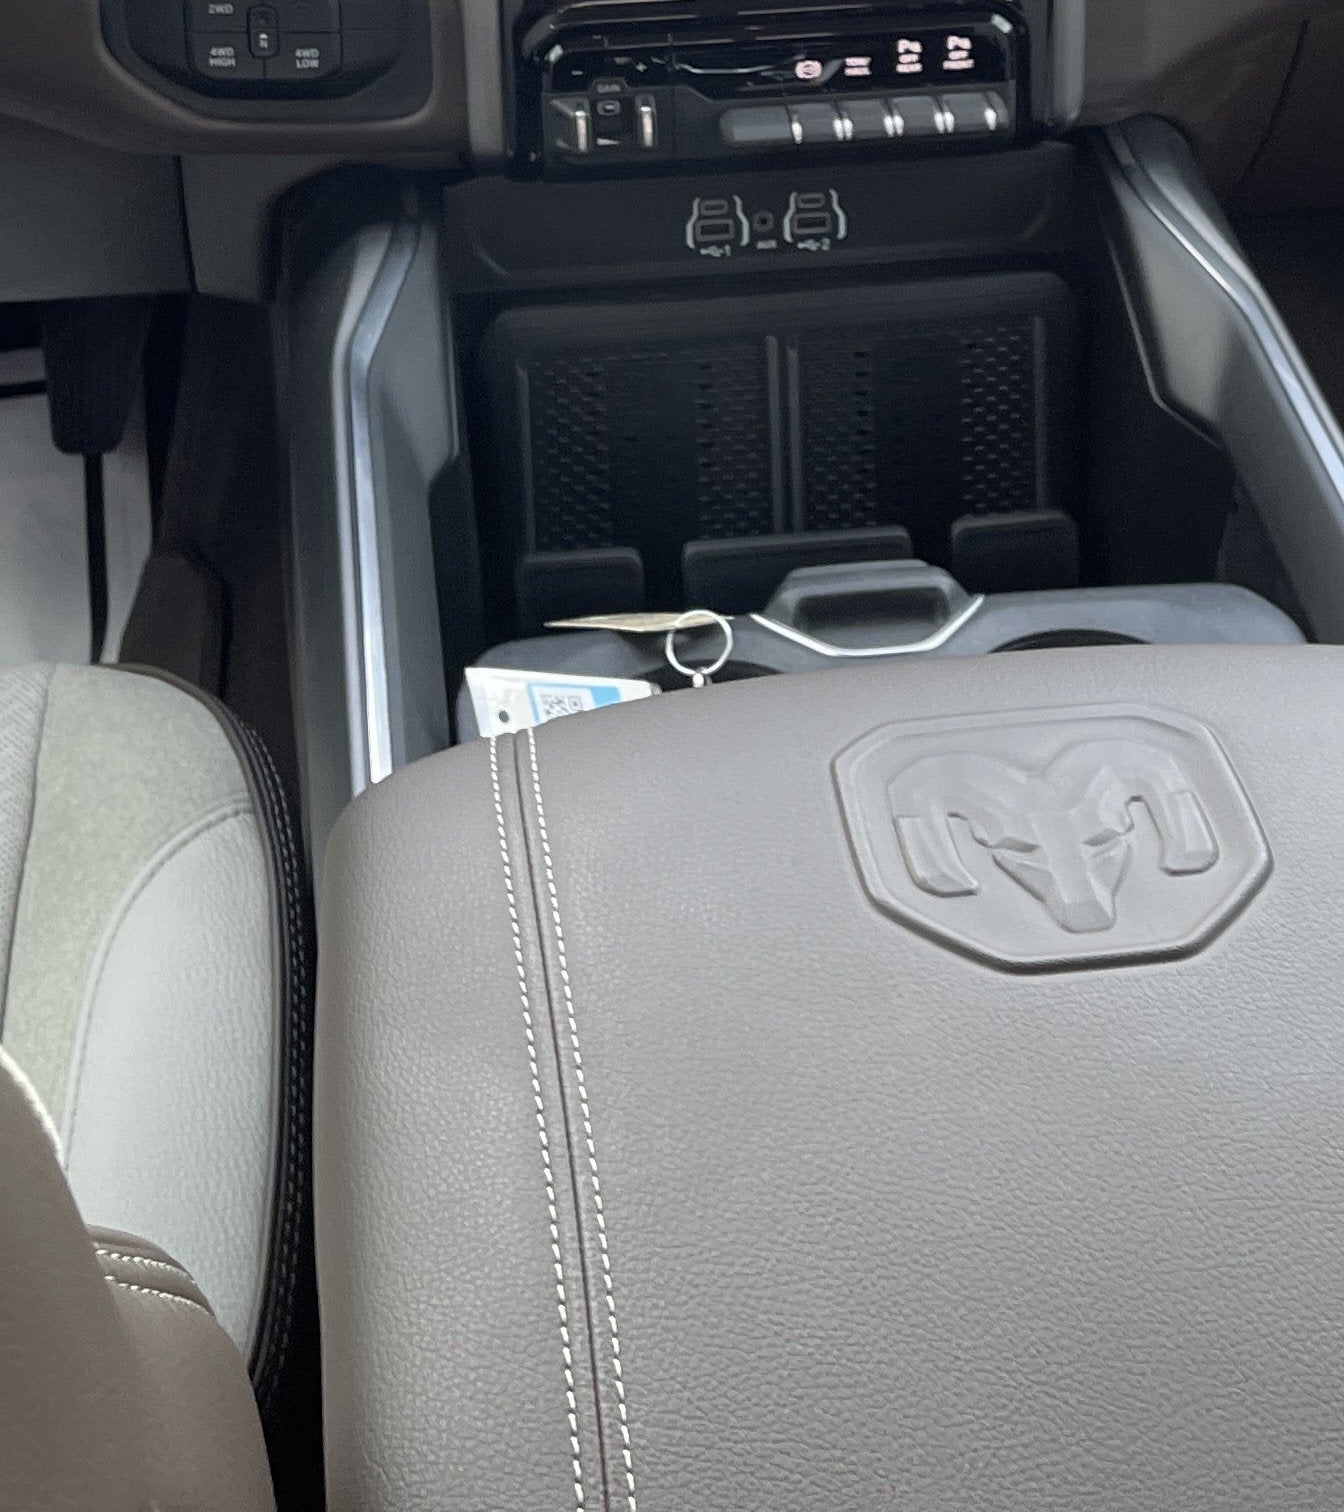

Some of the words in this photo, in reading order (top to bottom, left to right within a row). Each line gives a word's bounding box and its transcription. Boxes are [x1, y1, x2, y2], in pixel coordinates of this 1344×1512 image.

[208, 4, 234, 16] 2WD
[208, 57, 236, 68] HIGH
[295, 59, 320, 70] LOW
